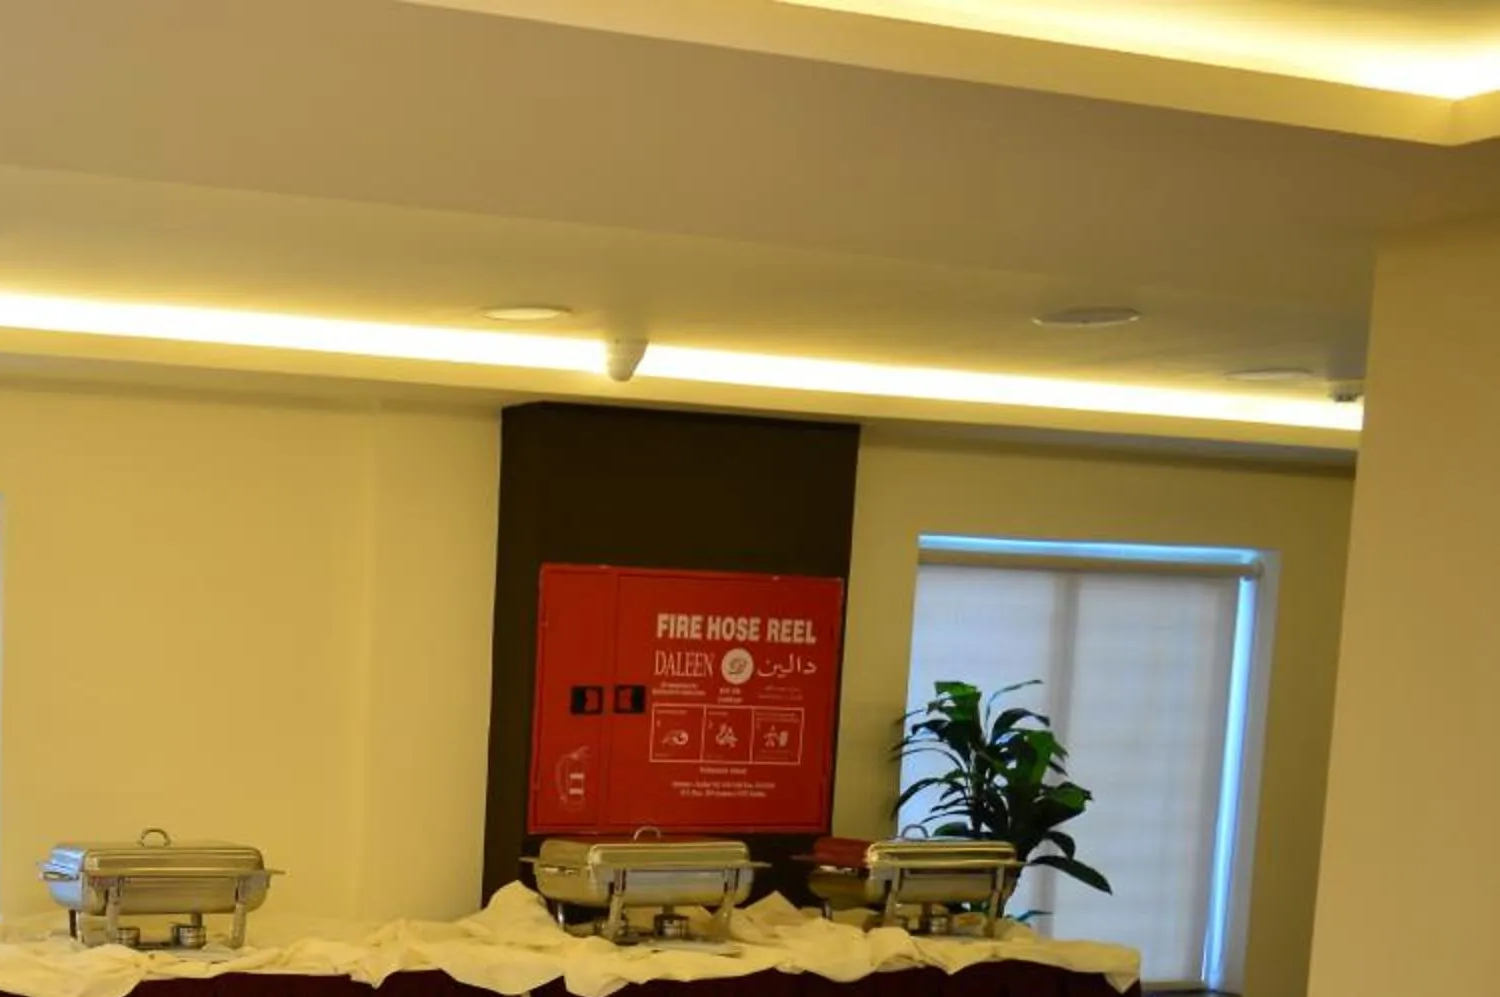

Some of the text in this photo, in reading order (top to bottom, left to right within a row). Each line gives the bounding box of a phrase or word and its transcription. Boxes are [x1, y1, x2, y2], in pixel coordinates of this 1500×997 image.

[657, 613, 817, 644] FIRE HOSE REEL
[653, 650, 715, 677] DALEEN
[757, 653, 817, 679] دالين
